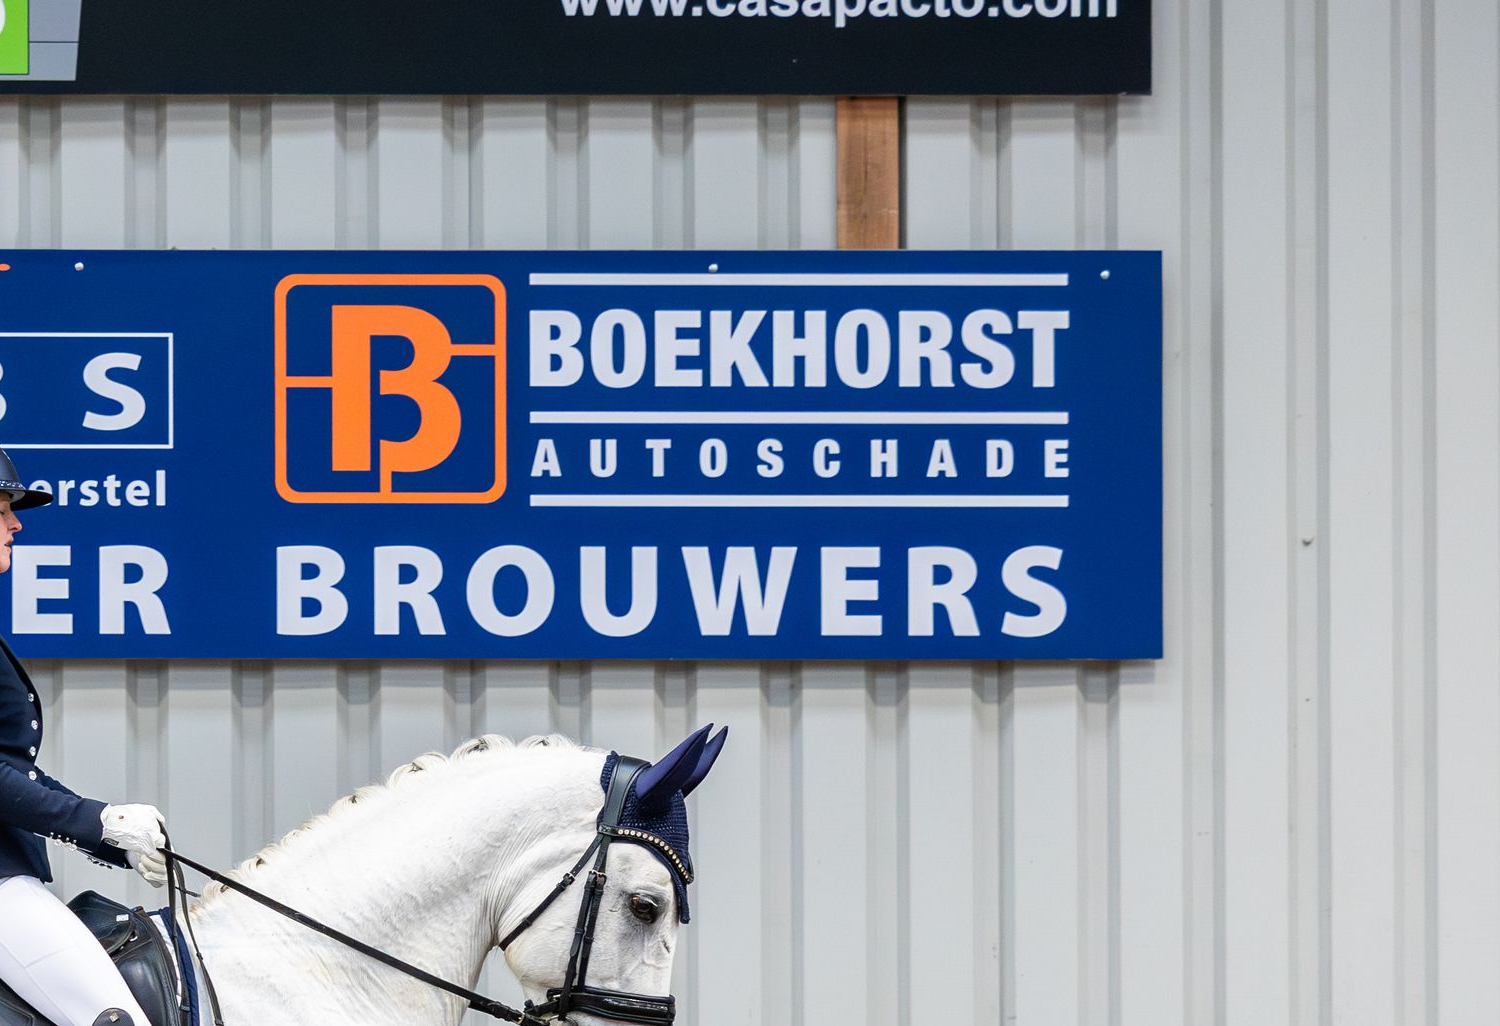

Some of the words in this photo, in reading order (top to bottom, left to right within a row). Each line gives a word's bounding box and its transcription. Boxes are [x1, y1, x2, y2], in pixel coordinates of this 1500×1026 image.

[529, 308, 1070, 389] BOEKHORST
[530, 438, 1070, 479] AUTOSCHADE
[276, 544, 1068, 638] BROUWERS
